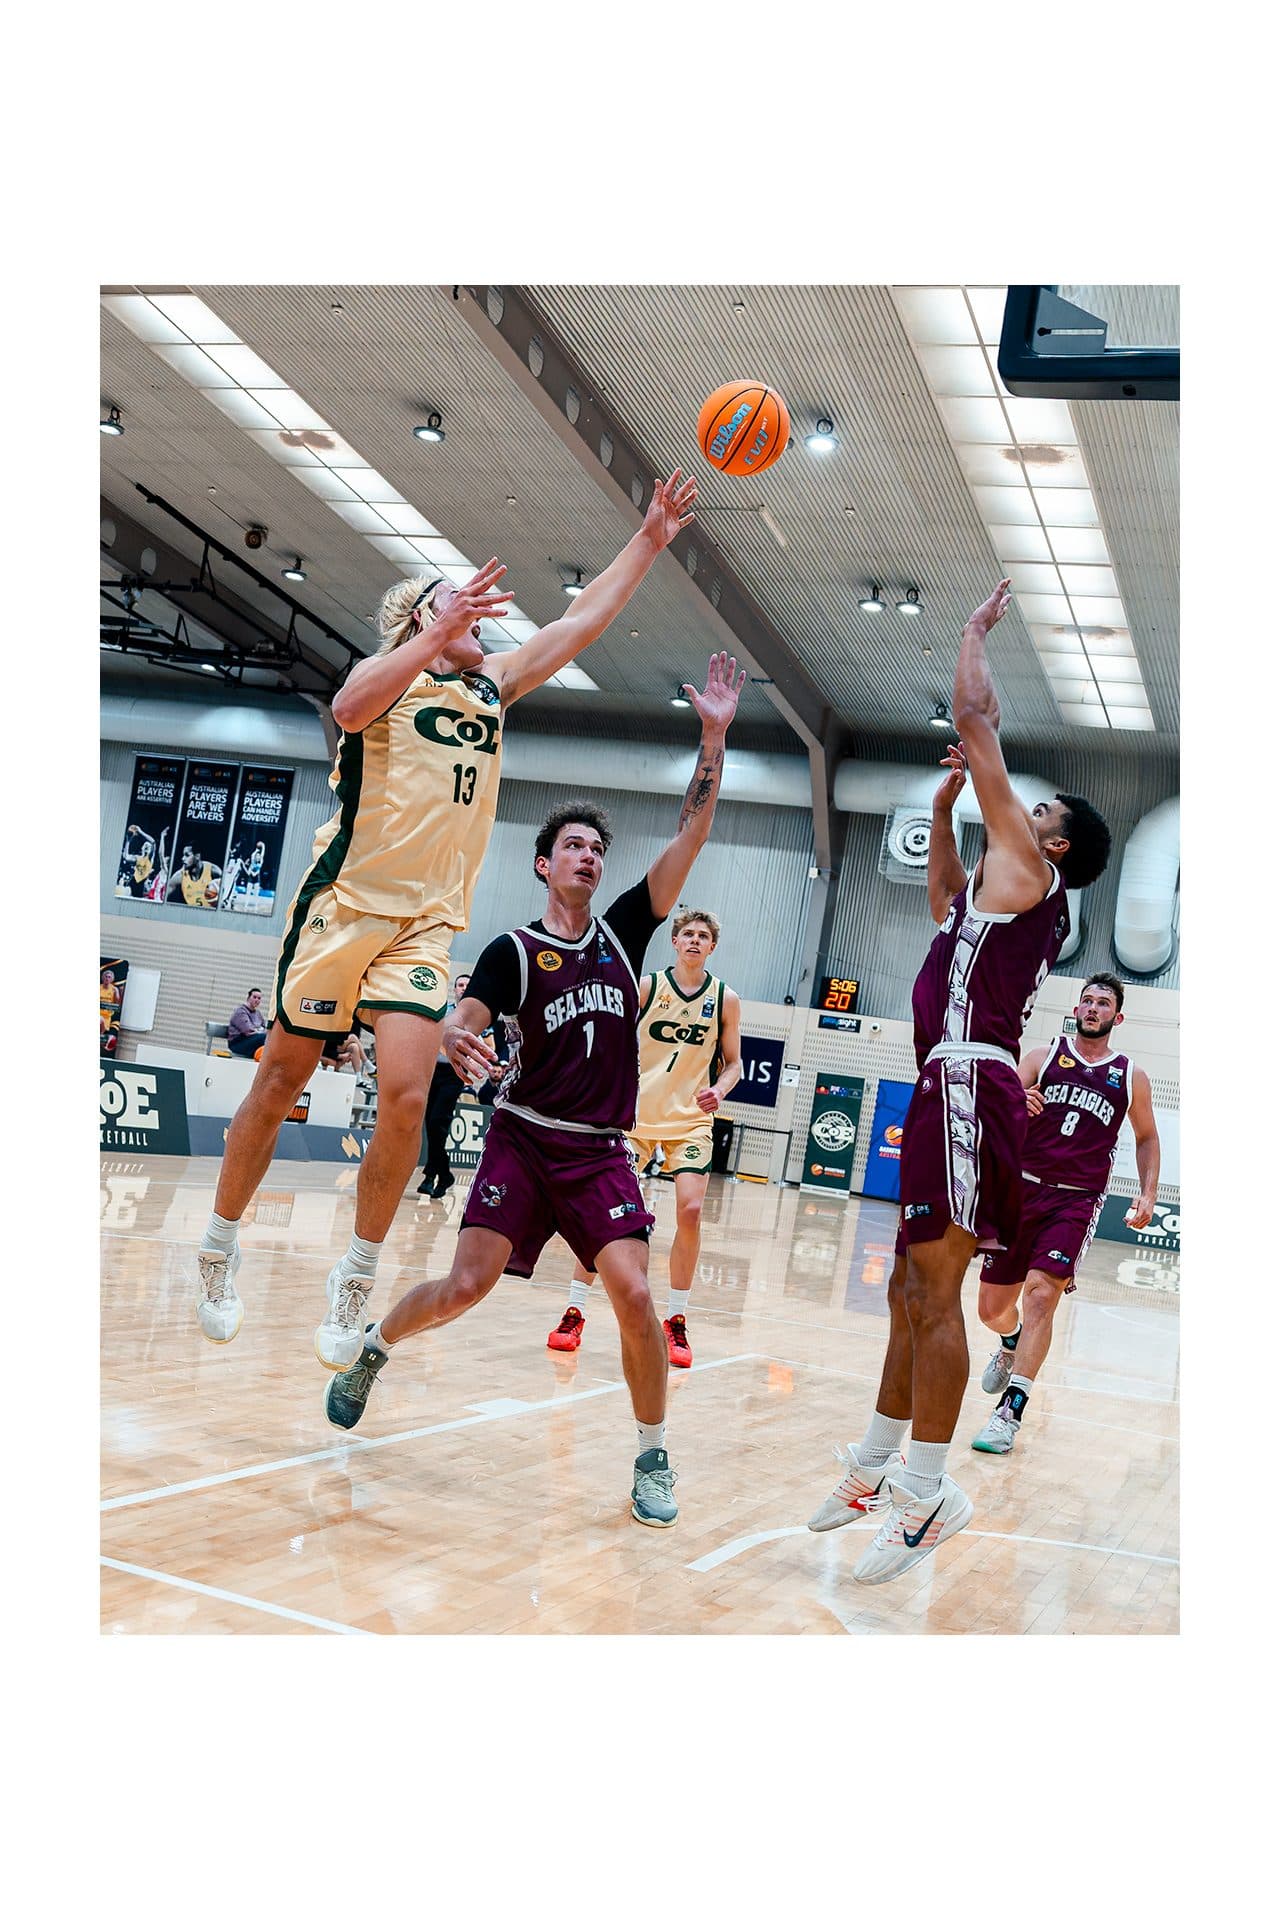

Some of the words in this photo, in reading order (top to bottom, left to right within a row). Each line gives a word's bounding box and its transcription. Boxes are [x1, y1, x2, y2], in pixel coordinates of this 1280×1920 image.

[709, 403, 752, 459] Wilson
[137, 786, 174, 798] PLAYERS
[191, 784, 229, 794] AUSTRALIAN
[452, 763, 477, 806] 13
[188, 800, 206, 811] ARE
[189, 791, 227, 803] PLAYERS
[243, 797, 282, 810] PLAYERS
[186, 809, 224, 822] PLAYERS
[241, 813, 280, 823] ADVERSITY
[255, 807, 281, 816] HANDLE
[830, 978, 857, 993] 5:06
[824, 991, 851, 1010] 20
[543, 991, 577, 1034] SEA
[583, 1020, 595, 1059] 1
[648, 1020, 710, 1046] CoE
[666, 1051, 679, 1073] 1
[100, 1068, 160, 1130] oE
[1044, 1084, 1069, 1104] SEA
[1068, 1086, 1115, 1127] EAGLES
[445, 1108, 484, 1152] oE
[1060, 1110, 1080, 1137] 8
[1125, 1204, 1180, 1239] Co
[1136, 1233, 1180, 1248] BASKET
